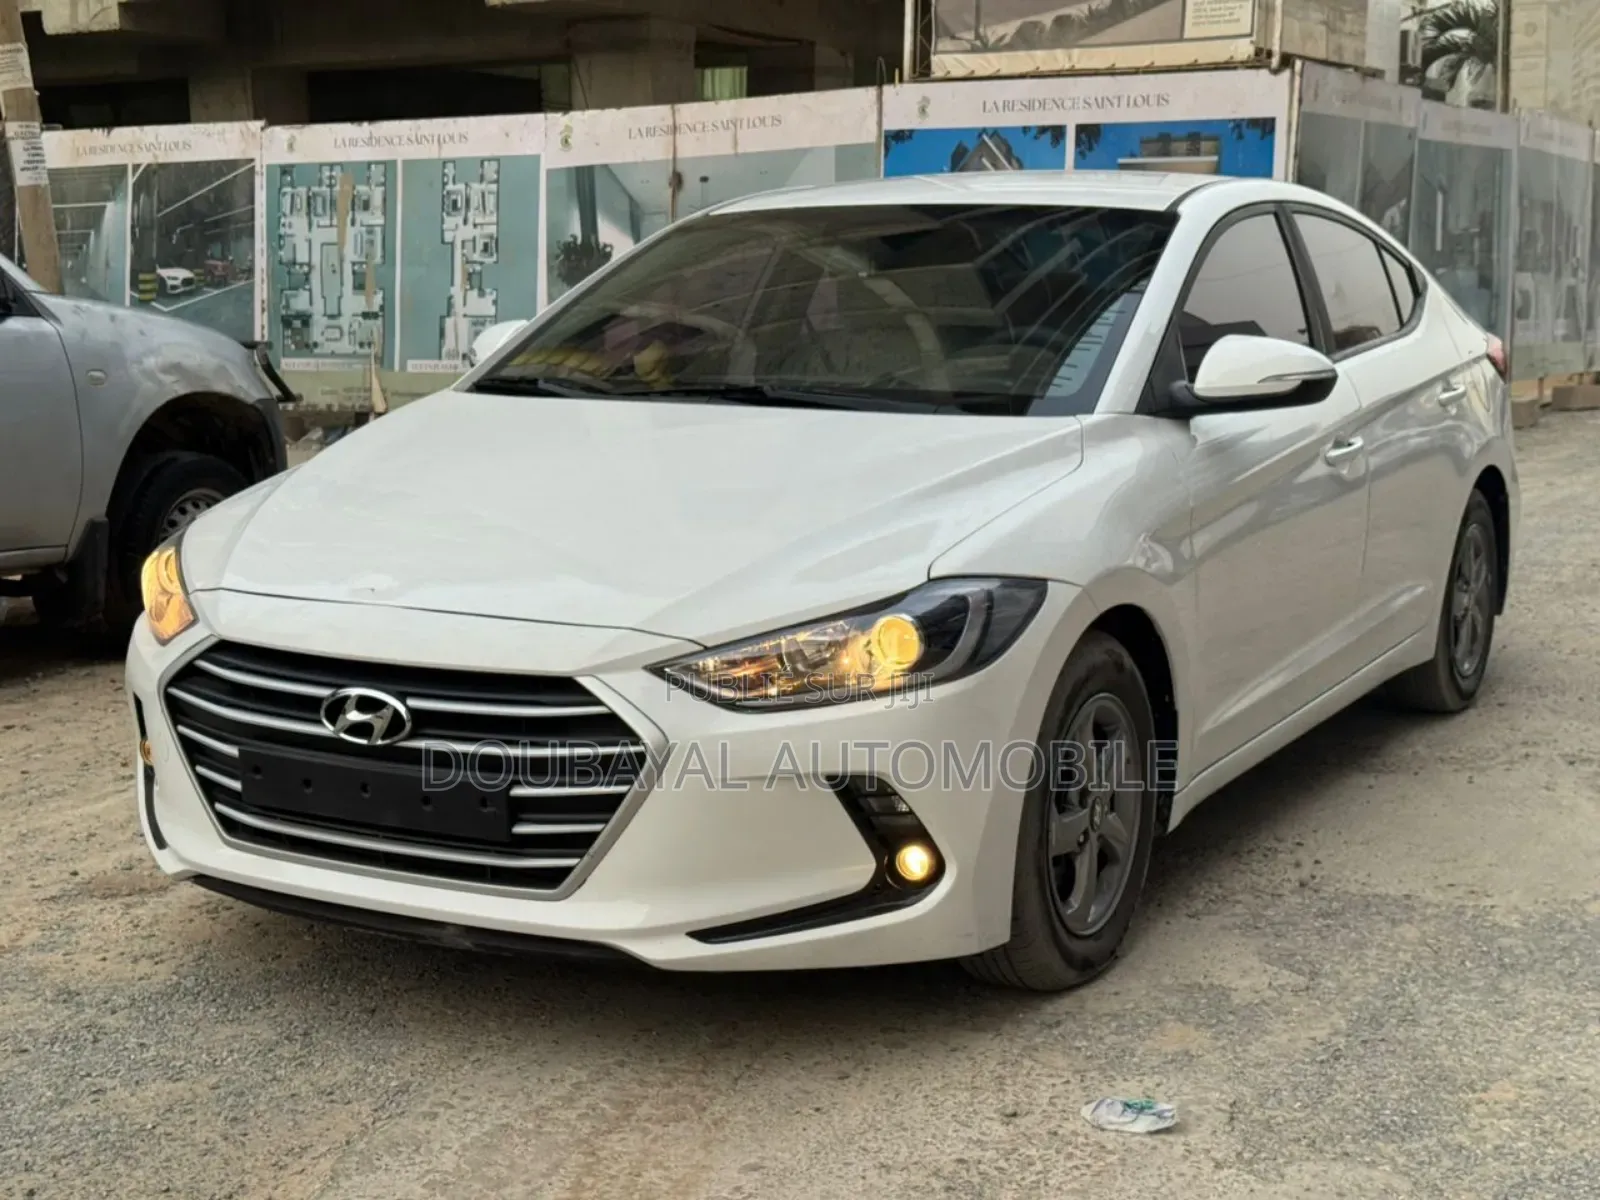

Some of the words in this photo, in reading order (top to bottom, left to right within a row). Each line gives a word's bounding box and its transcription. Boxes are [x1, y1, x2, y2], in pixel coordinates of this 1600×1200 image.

[982, 99, 1001, 114] LA
[1002, 96, 1081, 113] RESIDENCE
[1083, 94, 1123, 111] SAINT
[1125, 92, 1171, 109] LOUIS
[628, 127, 645, 140] LA
[710, 117, 745, 133] SAINT
[746, 114, 783, 130] LOUIS
[76, 147, 88, 157] LA
[88, 143, 135, 157] RESIDENCE
[136, 140, 163, 154] SAINT
[163, 139, 192, 152] LOUIS
[333, 137, 347, 149] LA
[347, 134, 404, 148] RESIDENCE
[406, 132, 436, 146] SAINT
[437, 131, 470, 145] LOUIS
